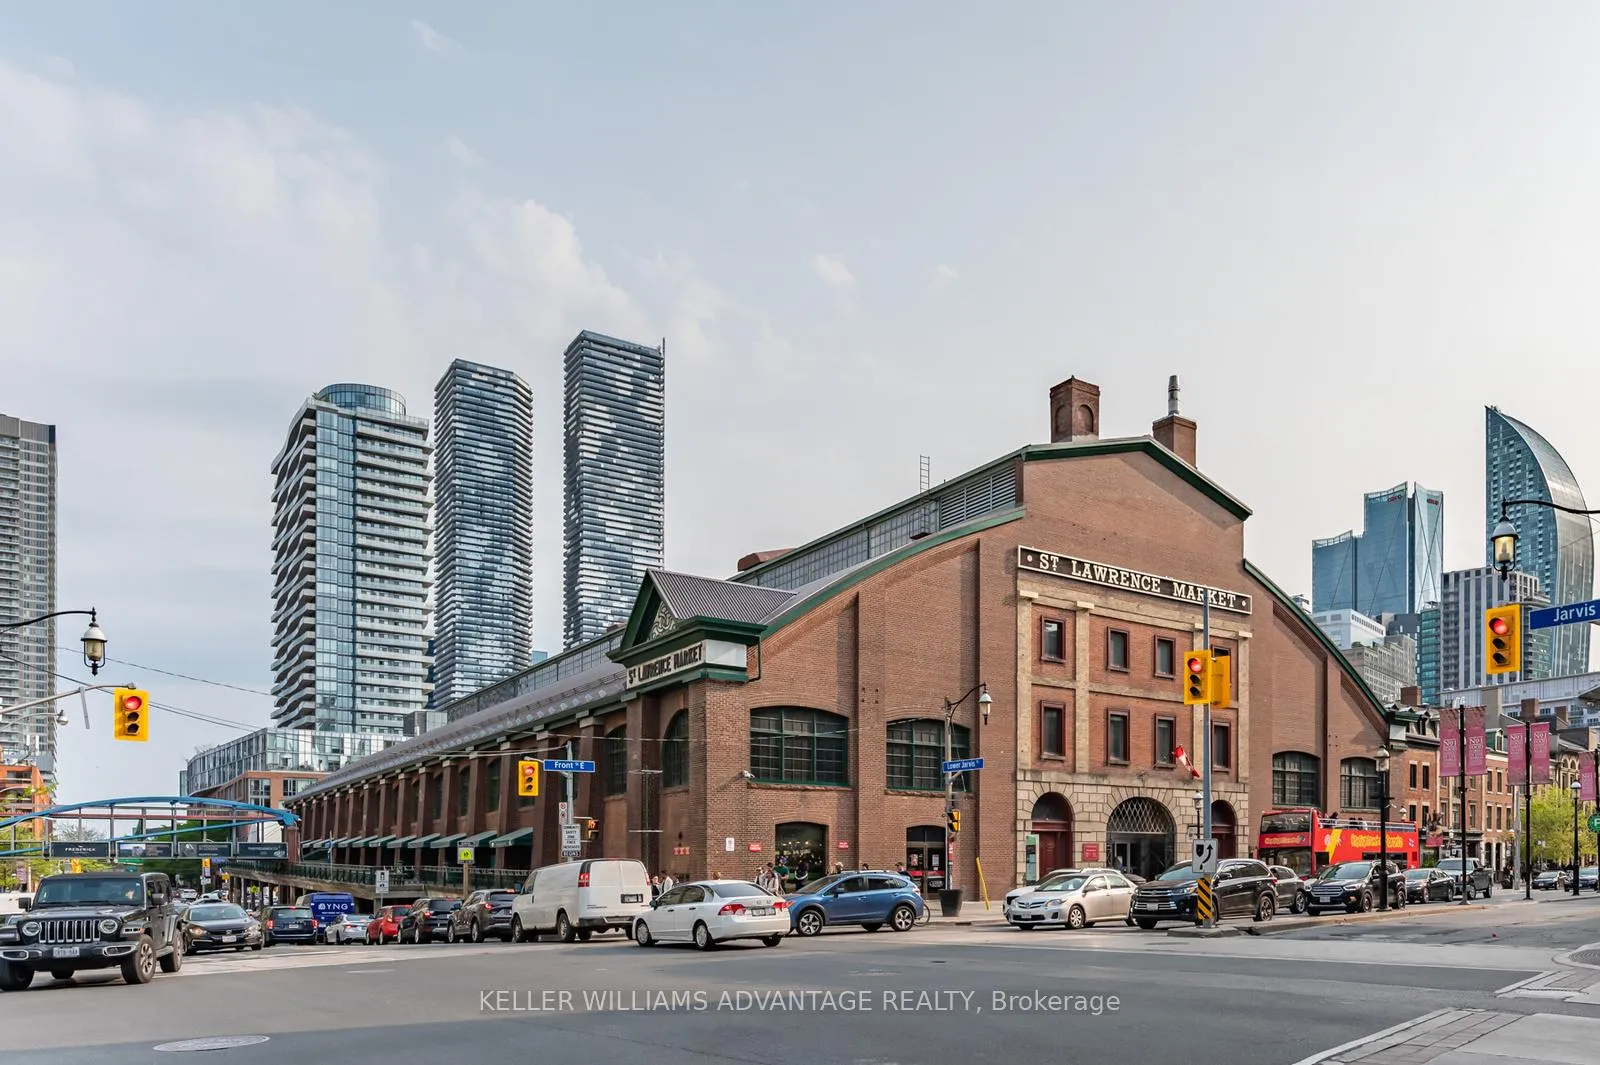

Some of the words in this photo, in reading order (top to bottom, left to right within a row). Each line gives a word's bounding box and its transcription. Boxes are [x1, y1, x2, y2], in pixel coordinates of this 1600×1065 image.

[1071, 560, 1161, 593] LAWRENCE
[1553, 603, 1596, 622] Jarvis
[637, 655, 672, 682] LAWRENCE
[673, 643, 703, 671] MARKET
[554, 761, 574, 769] Front
[580, 762, 585, 770] E
[961, 760, 976, 769] Jarvis
